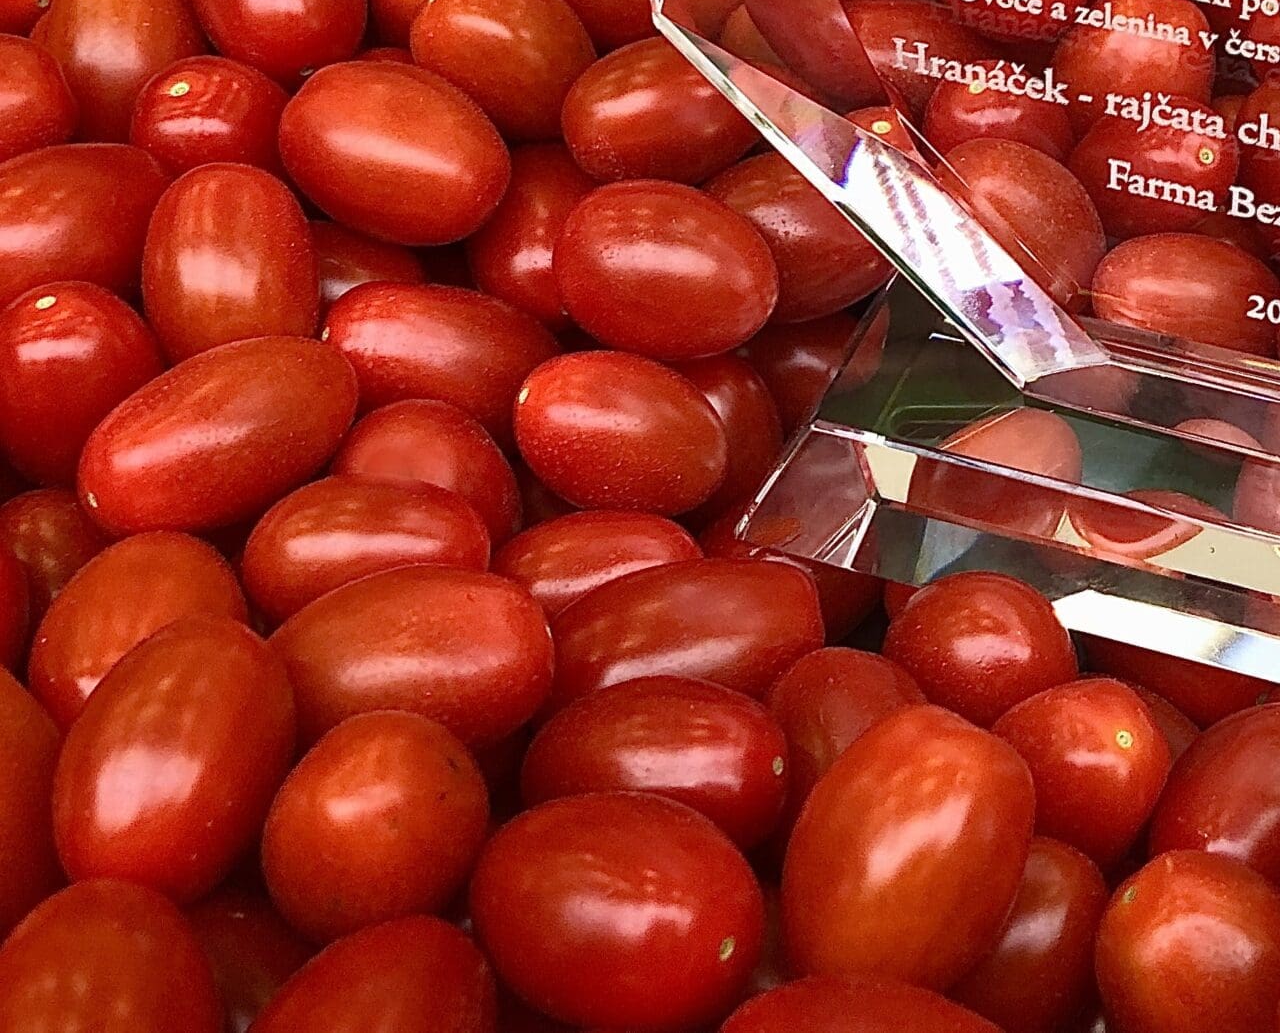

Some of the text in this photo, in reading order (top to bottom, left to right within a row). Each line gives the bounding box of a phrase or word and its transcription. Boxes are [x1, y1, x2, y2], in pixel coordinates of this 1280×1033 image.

[1050, 3, 1068, 22] a
[1075, 0, 1192, 47] zelenina
[1199, 29, 1220, 50] v
[892, 37, 1070, 106] Hranáček
[1103, 91, 1227, 139] rajčata
[1106, 159, 1218, 213] Farma
